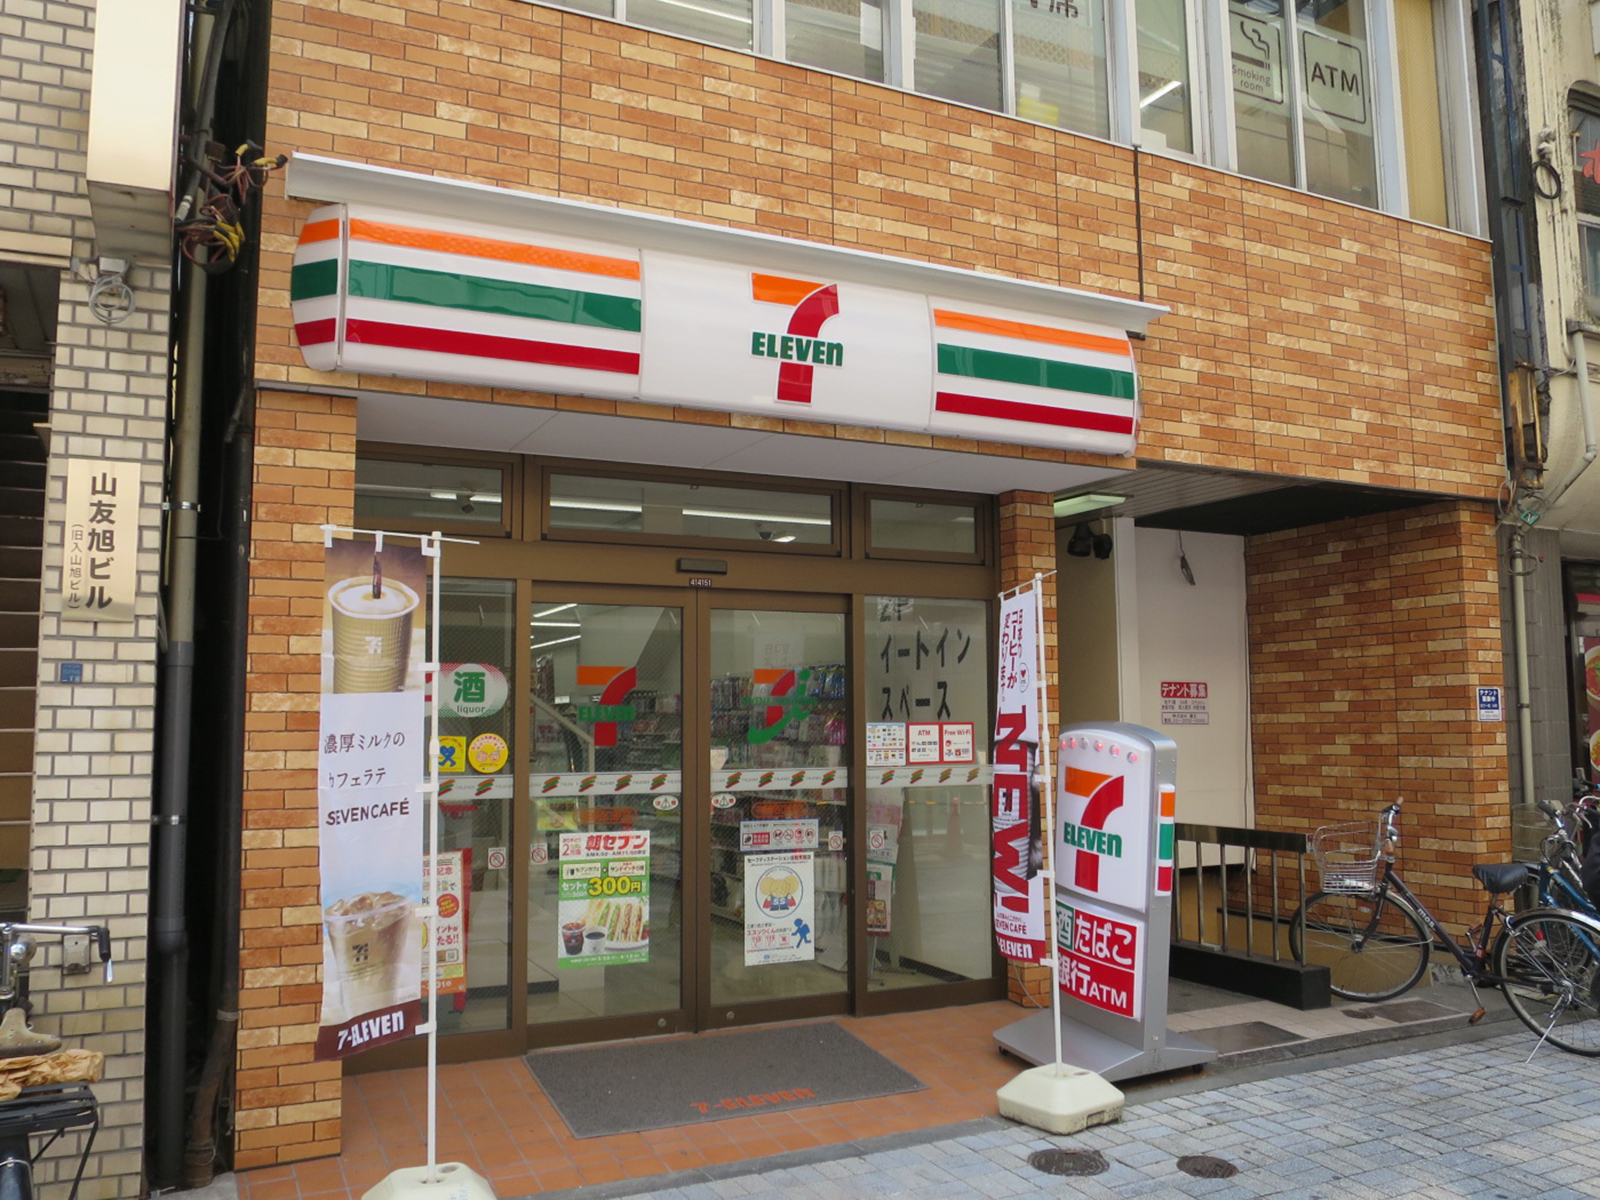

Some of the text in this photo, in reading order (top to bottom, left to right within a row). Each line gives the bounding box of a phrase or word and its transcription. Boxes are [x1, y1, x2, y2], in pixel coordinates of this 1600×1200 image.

[1232, 64, 1271, 87] Smoking
[1240, 79, 1263, 93] room
[1311, 62, 1359, 96] ATM
[85, 472, 117, 609] 山友旭ビル
[881, 627, 970, 673] イートイン
[1007, 610, 1018, 689] コーヒーが
[454, 671, 485, 702] 酒
[1162, 683, 1206, 697] テナント募集
[457, 705, 485, 714] liquor
[882, 681, 950, 720] スペース
[324, 732, 405, 754] 濃厚ミルクの
[585, 835, 648, 851] 朝セブン
[588, 876, 642, 896] 300円
[1075, 914, 1132, 965] たばこ
